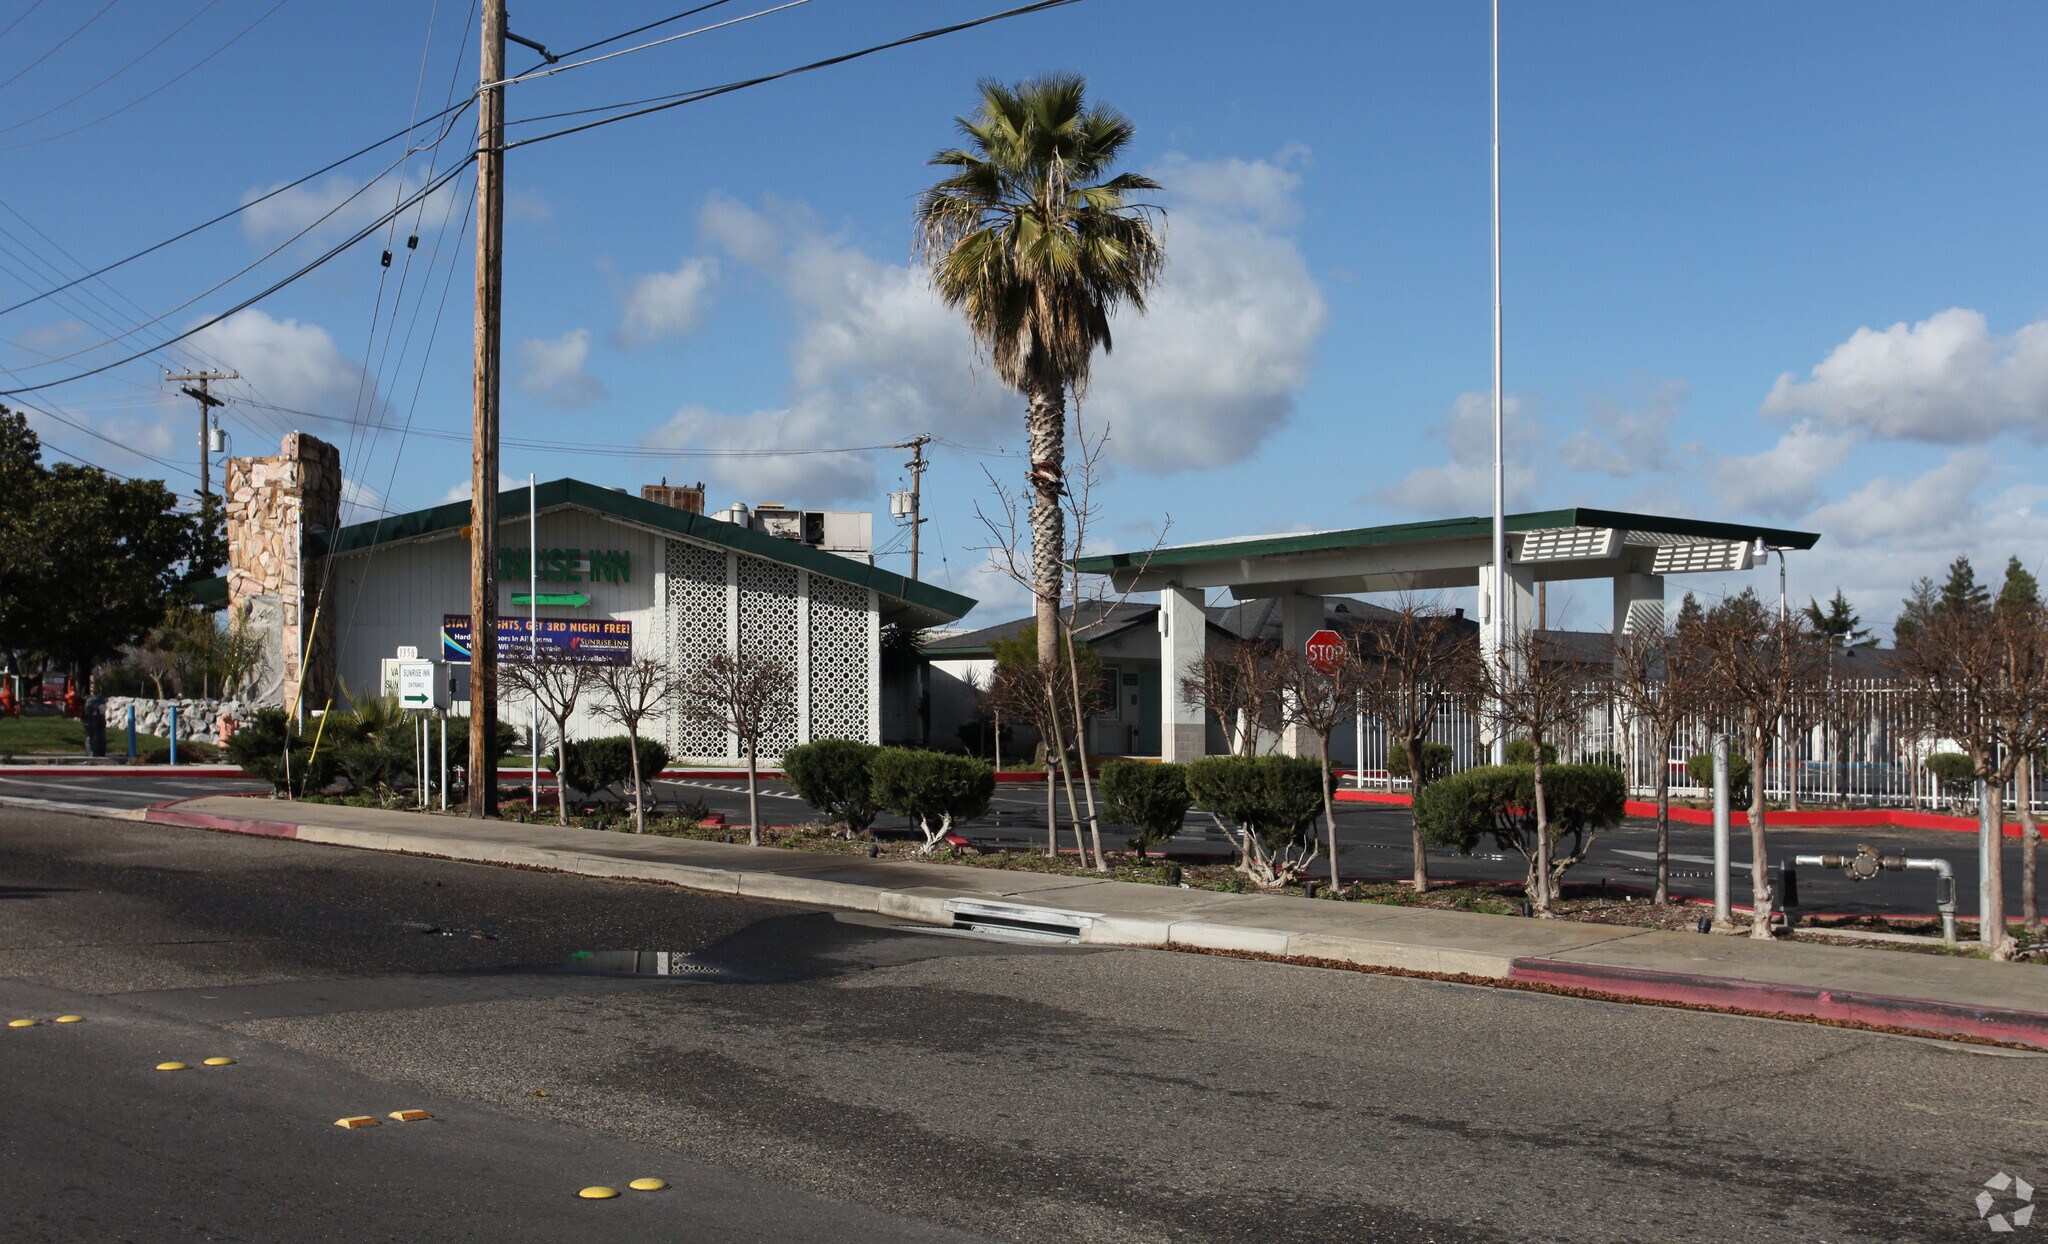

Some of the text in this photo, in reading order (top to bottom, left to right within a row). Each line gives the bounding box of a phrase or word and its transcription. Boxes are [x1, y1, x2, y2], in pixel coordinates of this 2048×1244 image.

[589, 549, 630, 583] INN
[445, 618, 468, 628] STAY
[547, 622, 567, 631] 3RD
[570, 622, 601, 633] NIGHT
[604, 623, 630, 634] FREE!
[1309, 644, 1344, 661] STOP
[403, 668, 431, 677] SUNRISE INN
